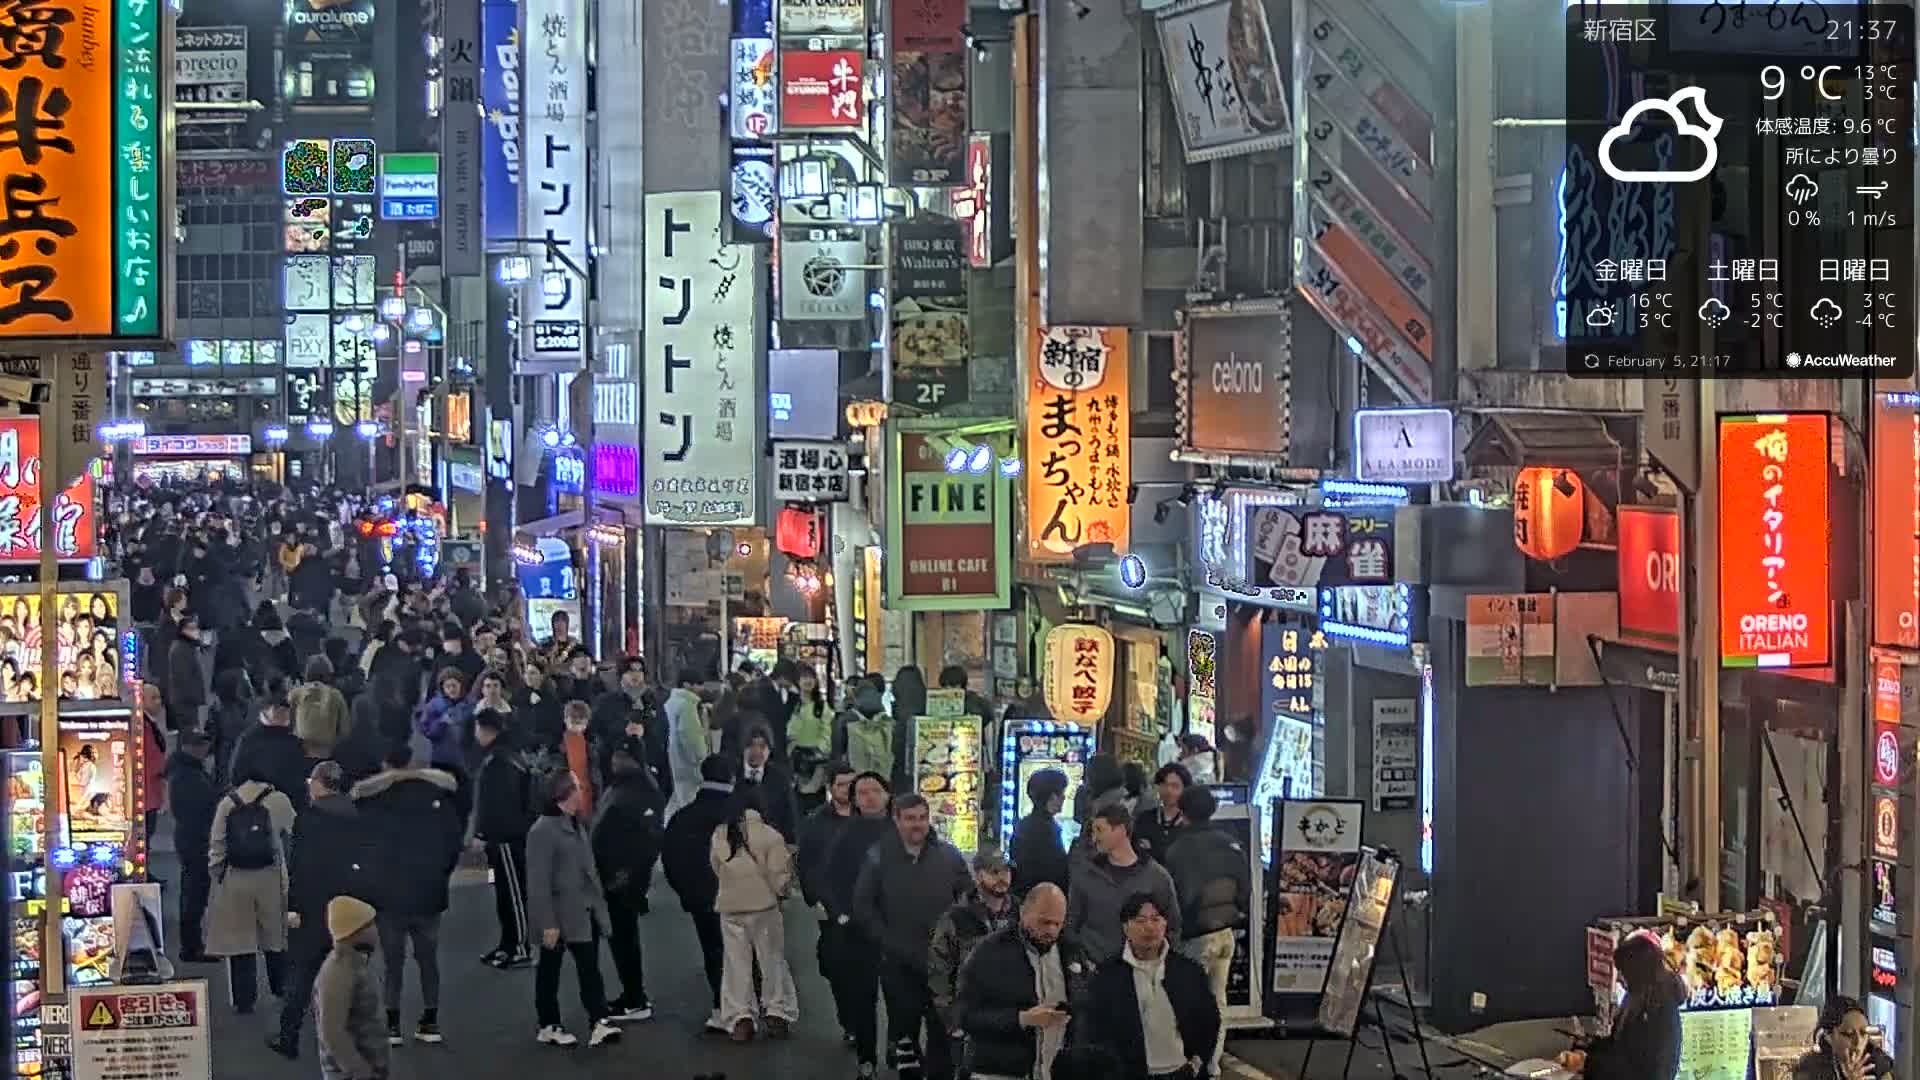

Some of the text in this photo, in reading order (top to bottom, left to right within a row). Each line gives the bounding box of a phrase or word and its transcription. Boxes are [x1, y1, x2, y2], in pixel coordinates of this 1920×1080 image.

[1312, 20, 1334, 41] 5
[541, 13, 569, 123] 焼とん酒場
[1314, 72, 1332, 89] 4
[1313, 120, 1334, 141] 3
[1311, 170, 1333, 191] 2
[901, 254, 960, 269] Walton's
[659, 207, 692, 462] トントン
[713, 323, 738, 442] 焼とん酒場
[1211, 351, 1263, 394] celona
[71, 352, 92, 444] 通り一番街
[916, 383, 946, 403] 2F
[779, 448, 843, 470] 酒場心
[1039, 394, 1086, 544] まっちゃん
[778, 474, 844, 493] 新宿本店
[910, 483, 986, 512] FINE
[1349, 519, 1389, 534] フリー
[1753, 429, 1790, 604] 俺のイタリアン
[909, 558, 988, 573] ONLINE CAFE
[1740, 614, 1808, 633] ORENO
[1739, 632, 1809, 651] ITALIAN
